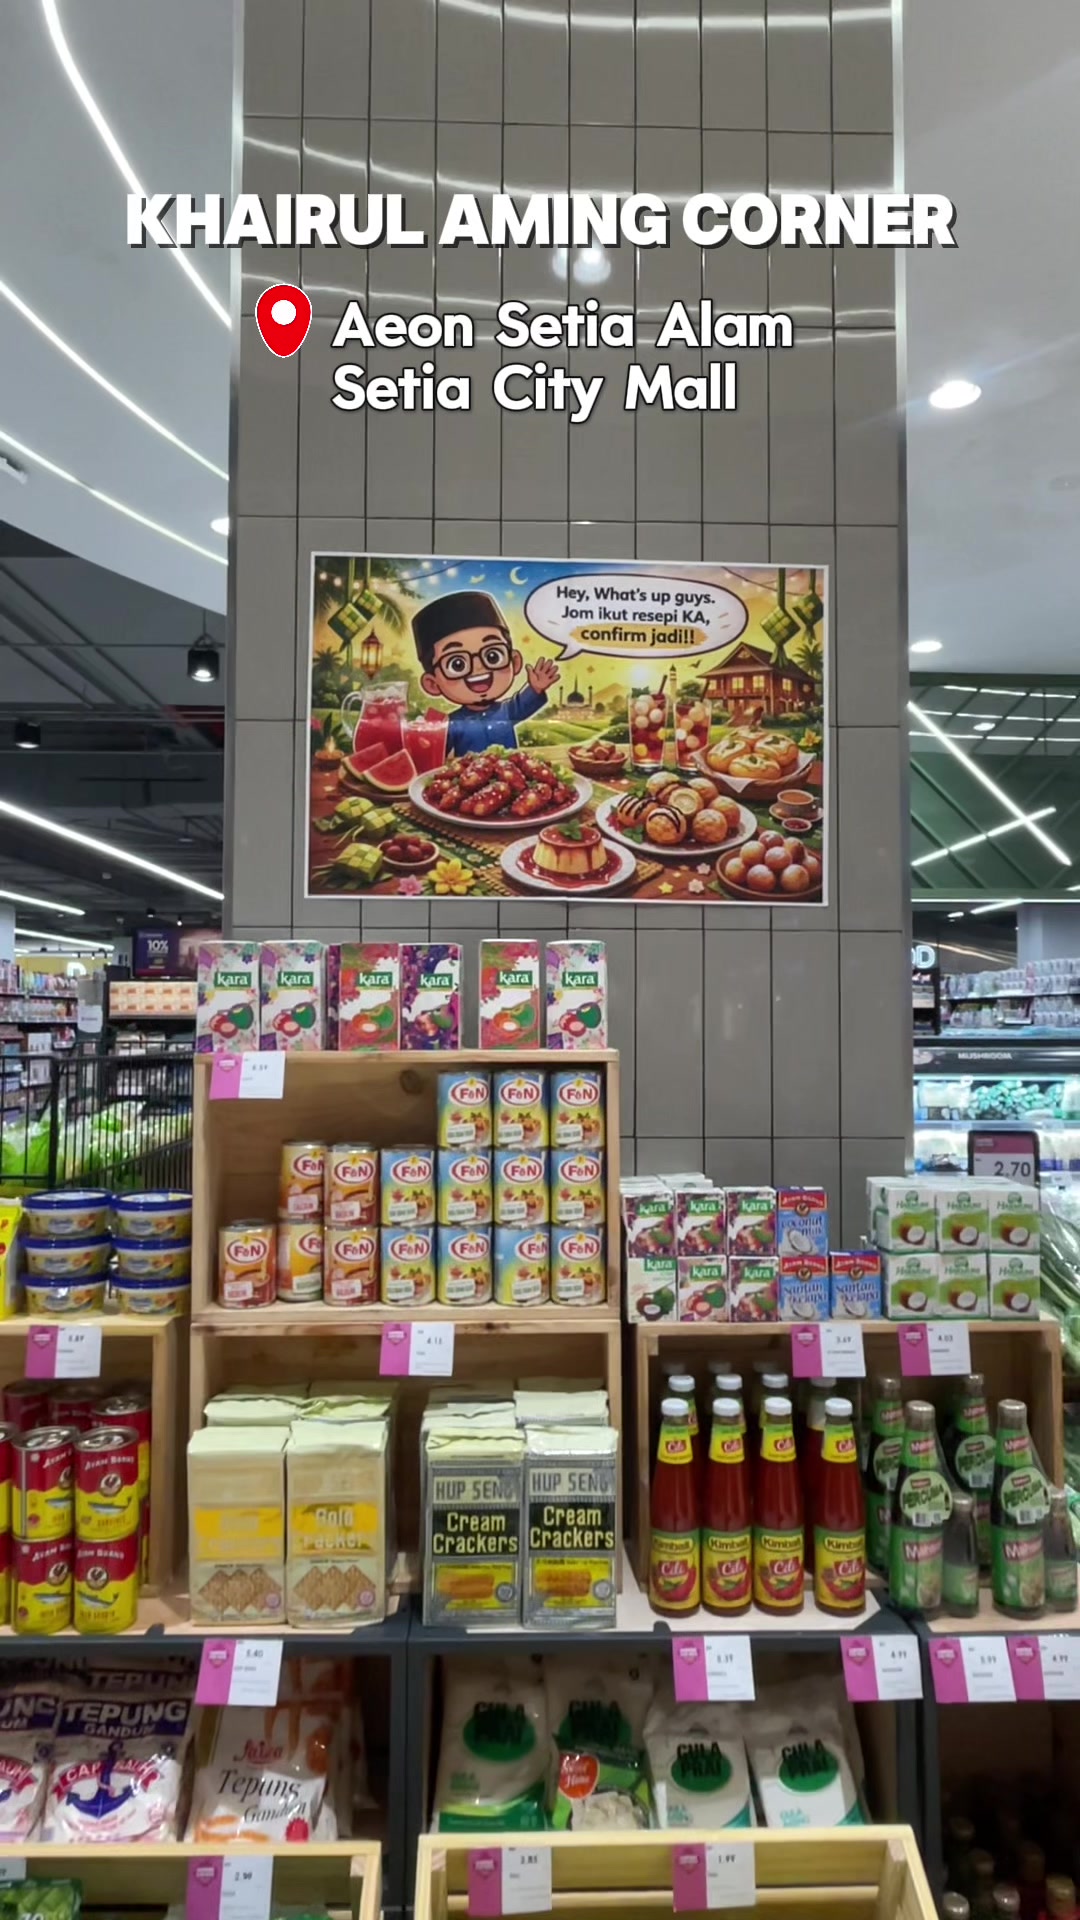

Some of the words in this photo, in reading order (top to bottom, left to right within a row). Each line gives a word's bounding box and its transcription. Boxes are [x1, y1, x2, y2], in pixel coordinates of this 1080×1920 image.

[556, 586, 590, 602] Hey,
[594, 587, 647, 602] What's
[651, 592, 671, 606] up
[675, 592, 716, 606] guys.
[561, 606, 594, 621] Jom
[598, 606, 628, 622] ikut
[632, 610, 678, 626] resepi
[682, 611, 711, 627] KA,
[580, 626, 647, 644] confirm
[650, 628, 695, 648] jadi!!
[147, 940, 169, 952] 10%
[217, 973, 248, 987] kara
[281, 973, 311, 986] kara
[359, 973, 390, 986] kara
[420, 974, 450, 988] kara
[500, 972, 529, 985] kara
[565, 973, 595, 986] kara
[460, 1088, 485, 1100] F&N
[508, 1088, 534, 1099] F&N
[567, 1088, 592, 1100] F&N
[342, 1165, 368, 1178] F&N
[402, 1166, 427, 1178] F&N
[461, 1165, 486, 1177] F&N
[511, 1165, 537, 1177] F&N
[568, 1166, 594, 1177] F&N
[994, 1161, 1031, 1177] 2.70
[639, 1202, 665, 1214] kara
[690, 1201, 716, 1212] kara
[742, 1200, 768, 1212] kara
[234, 1244, 261, 1257] F&N
[343, 1243, 369, 1256] F&N
[400, 1243, 425, 1255] F&N
[460, 1242, 485, 1254] F&N
[568, 1242, 594, 1254] F&N
[647, 1258, 673, 1270] kara
[693, 1266, 718, 1278] kara
[744, 1267, 771, 1279] kara
[532, 1473, 562, 1492] HUP
[435, 1481, 466, 1499] HUP
[543, 1505, 602, 1526] Cream
[447, 1512, 506, 1533] Cream
[433, 1533, 518, 1554] Crackers
[530, 1527, 615, 1549] Crackers
[63, 1700, 187, 1725] TEPUNG
[218, 1768, 302, 1803] Tepung
